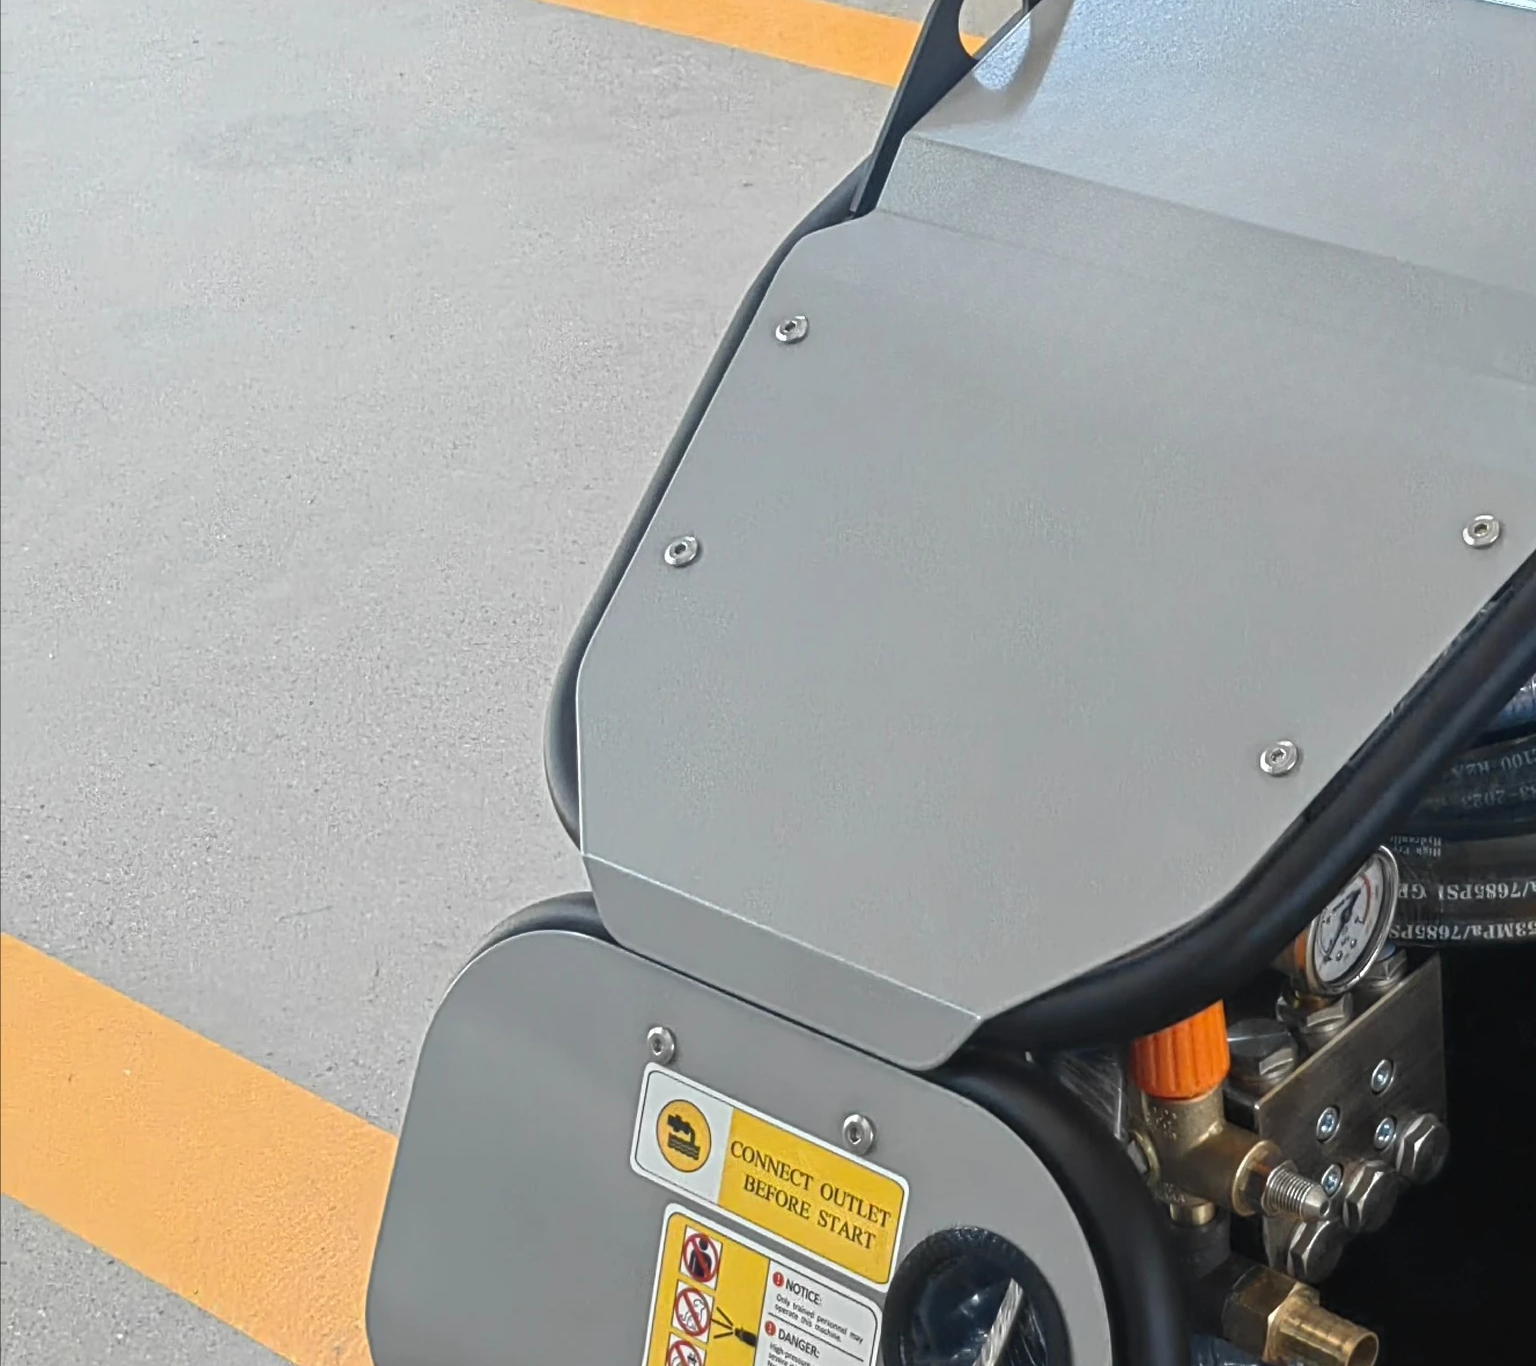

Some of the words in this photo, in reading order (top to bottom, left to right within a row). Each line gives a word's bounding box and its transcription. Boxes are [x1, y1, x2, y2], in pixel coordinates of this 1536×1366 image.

[730, 1140, 814, 1191] CONNECT
[820, 1182, 892, 1228] OUTLET
[743, 1173, 812, 1220] BEFORE
[817, 1209, 877, 1250] START
[785, 1278, 823, 1306] NOTICE:
[774, 1303, 799, 1321] operate
[800, 1316, 813, 1328] this
[814, 1322, 842, 1343] machine.
[776, 1293, 790, 1308] Only
[792, 1301, 815, 1319] trained
[849, 1331, 864, 1346] may
[777, 1327, 821, 1359] DANGER:
